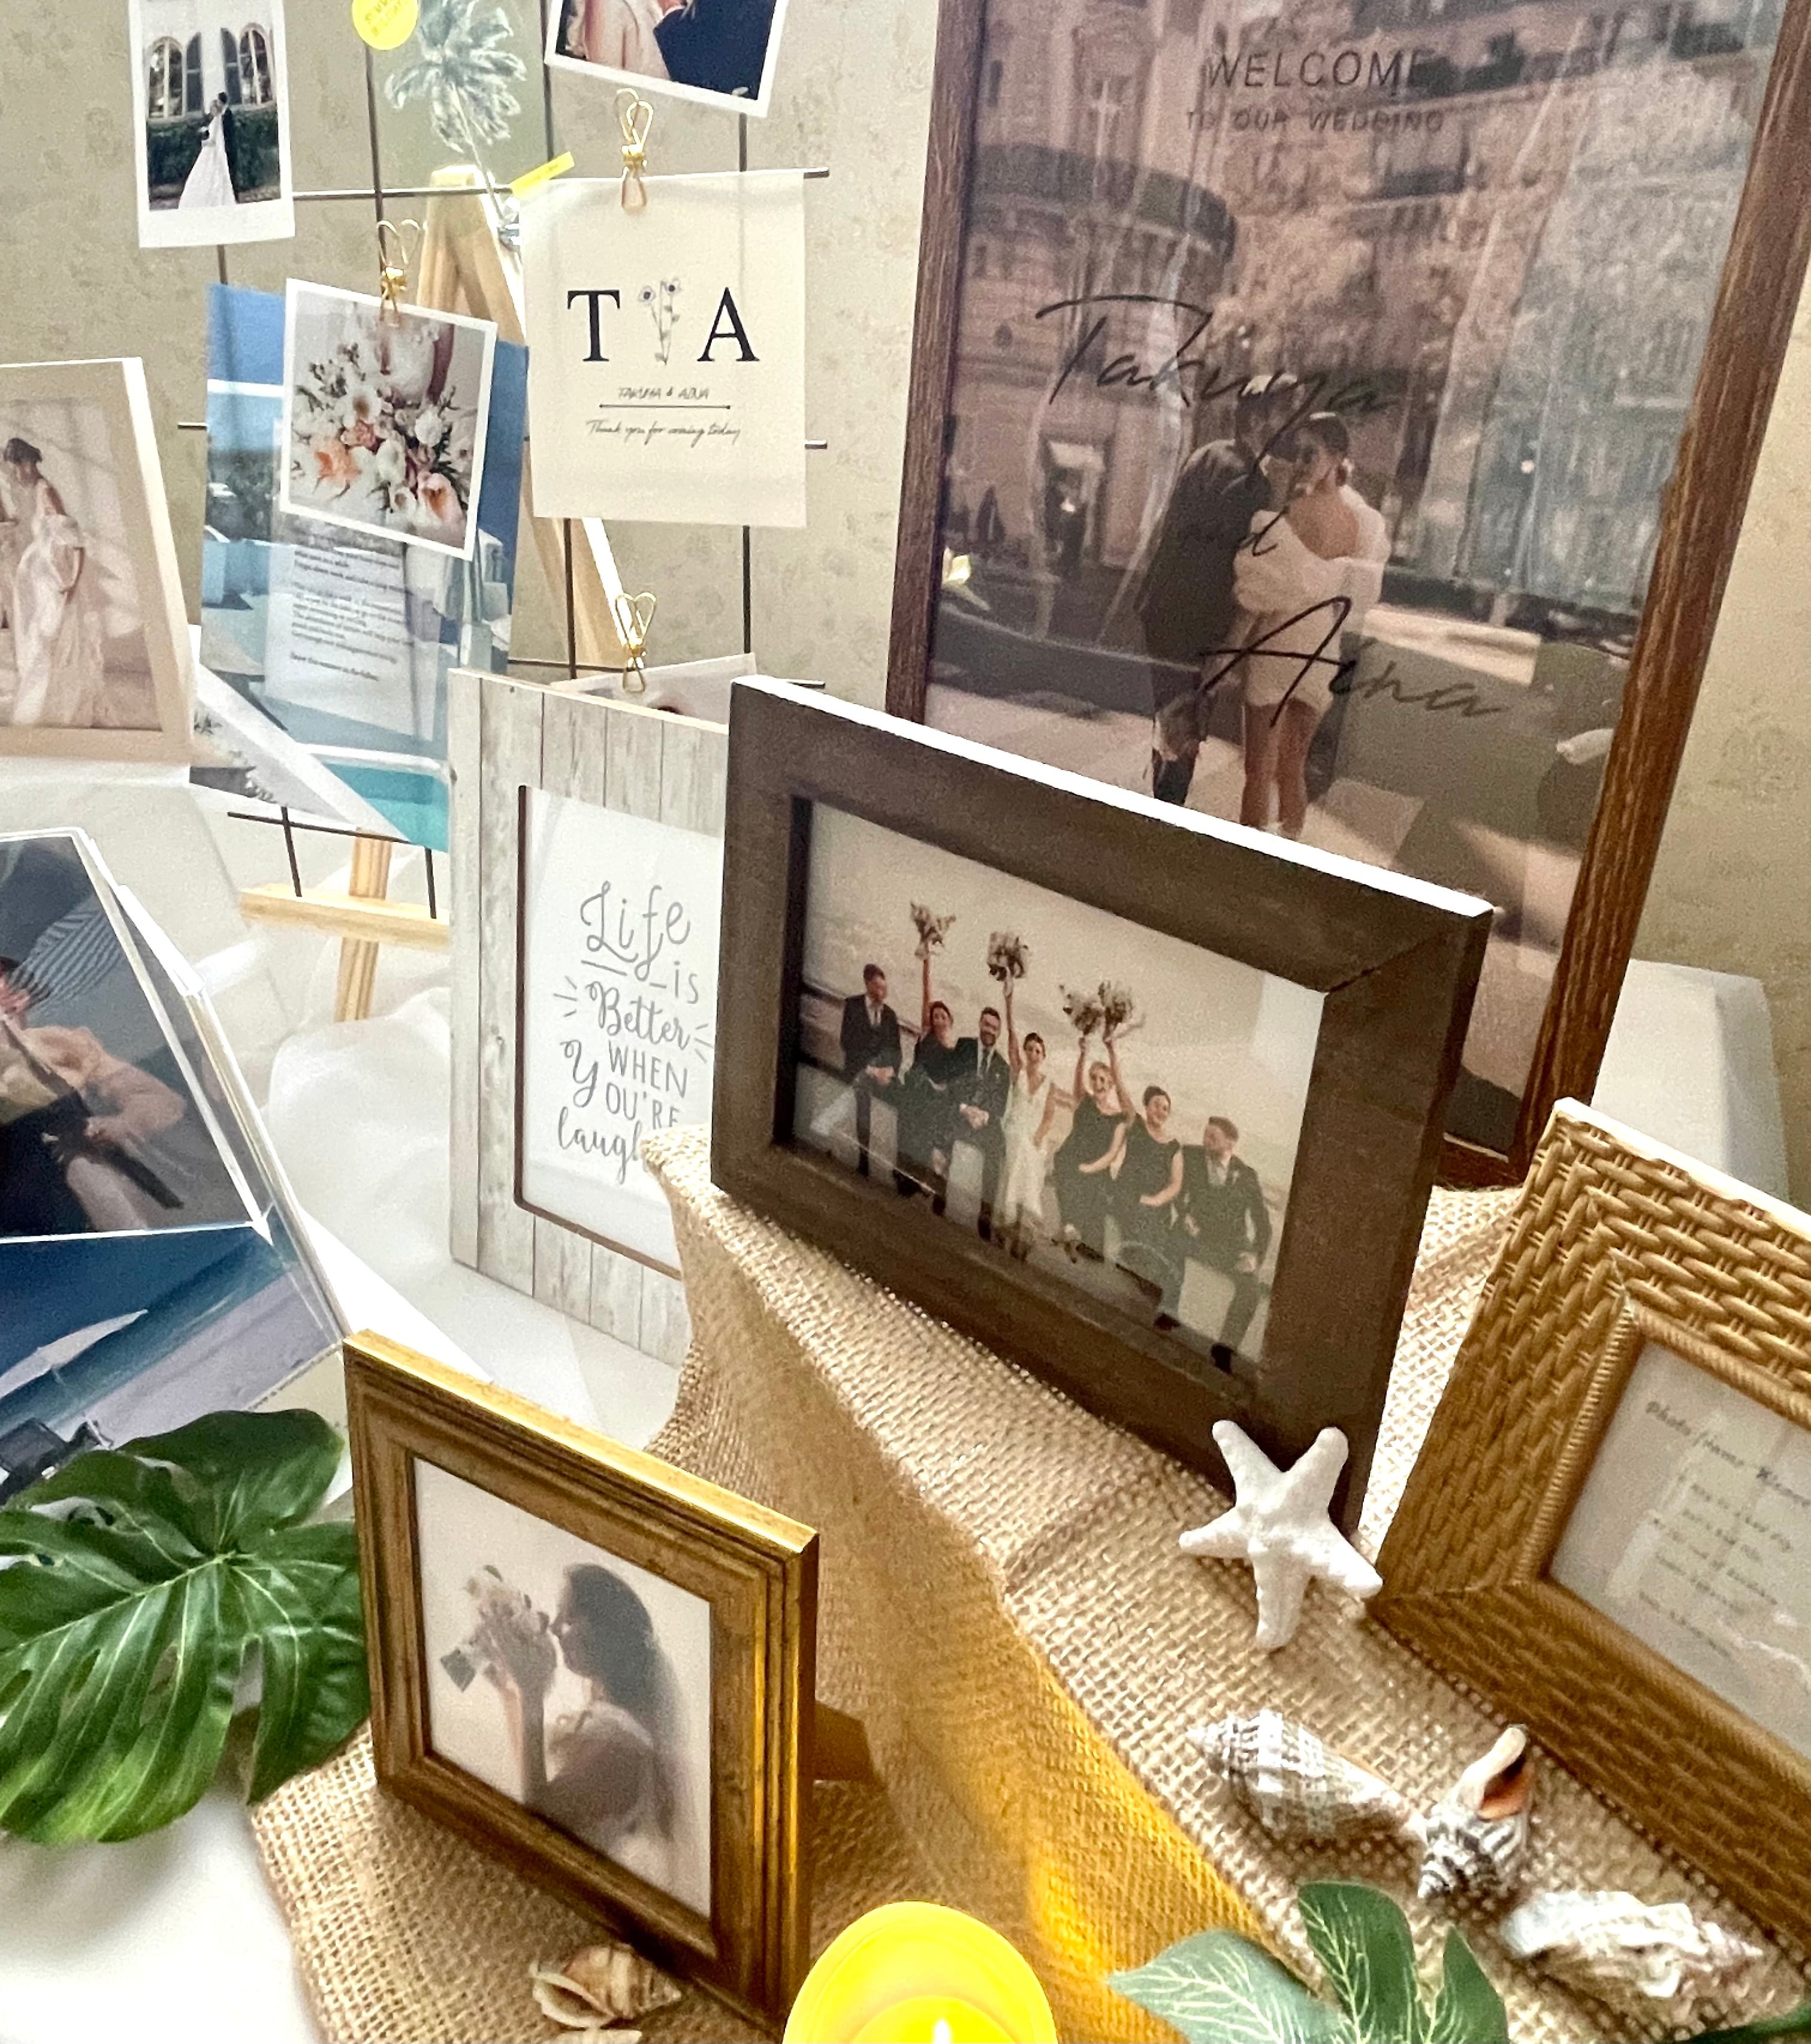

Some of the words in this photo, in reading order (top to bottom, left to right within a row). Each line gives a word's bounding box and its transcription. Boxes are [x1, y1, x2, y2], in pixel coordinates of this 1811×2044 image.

[1206, 49, 1435, 88] WELCOME
[1186, 110, 1215, 130] TO
[1233, 108, 1290, 131] OUR
[1308, 108, 1444, 132] WEDDING
[568, 289, 620, 362] T
[697, 286, 760, 362] A
[1036, 294, 1402, 473] Takuya
[585, 419, 622, 436] Thank
[625, 426, 645, 443] you
[644, 421, 665, 446] for
[668, 425, 705, 448] coming
[707, 422, 741, 446] today
[580, 880, 691, 982] Life
[674, 961, 699, 1004] is
[585, 980, 691, 1051] Better
[608, 1040, 689, 1099] WHEN
